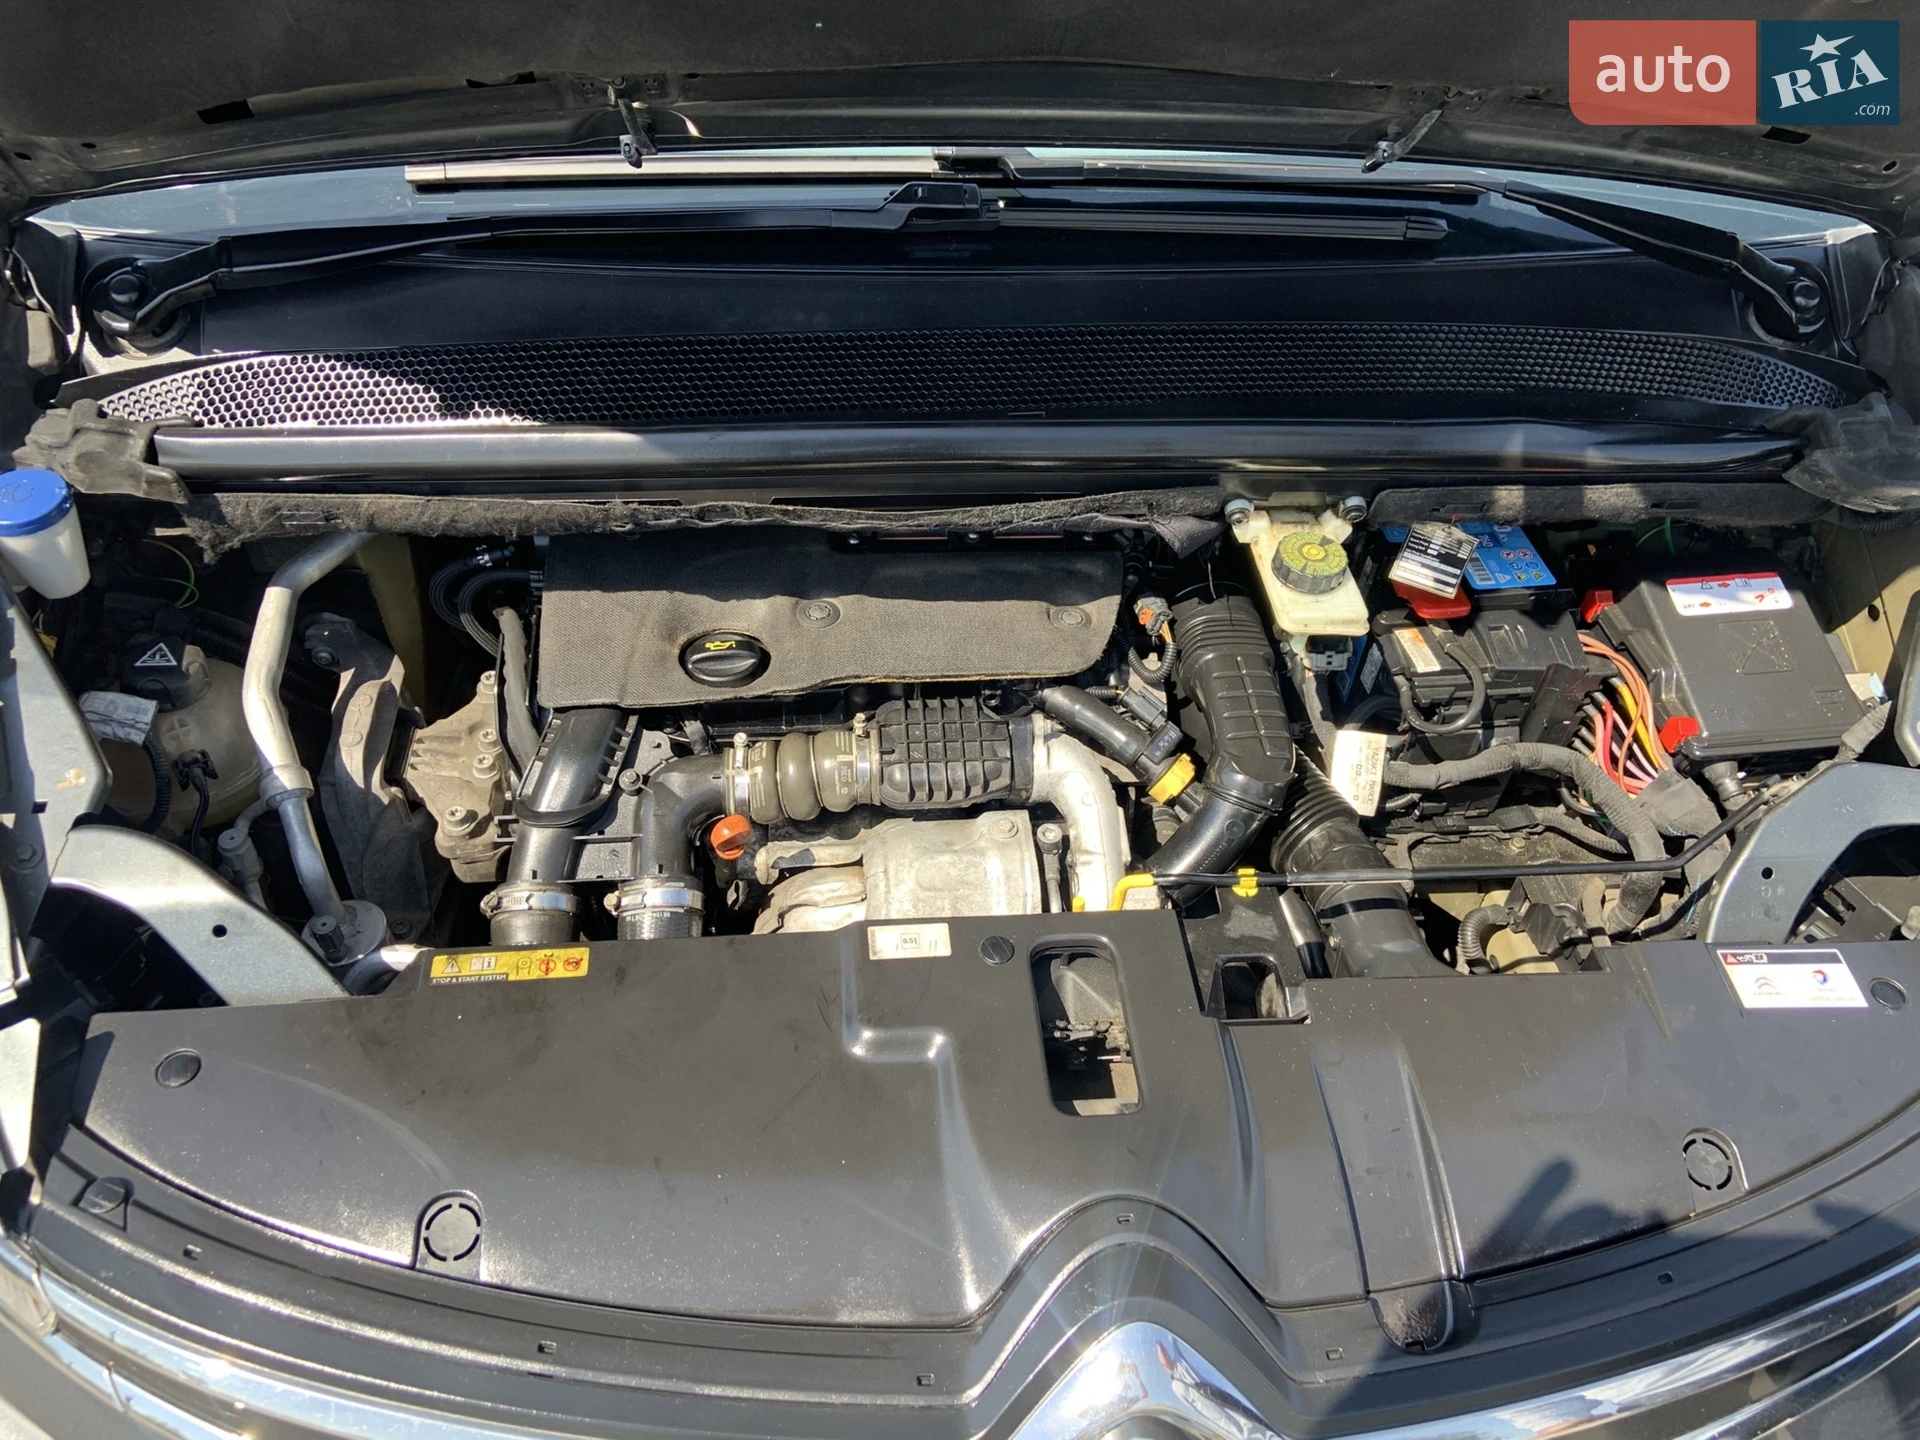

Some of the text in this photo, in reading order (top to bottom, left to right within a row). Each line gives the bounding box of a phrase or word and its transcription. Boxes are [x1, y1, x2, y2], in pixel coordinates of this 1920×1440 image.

[1366, 746, 1380, 806] YAZAKI MAROC
[458, 975, 479, 983] START
[480, 974, 507, 982] SYSTEM
